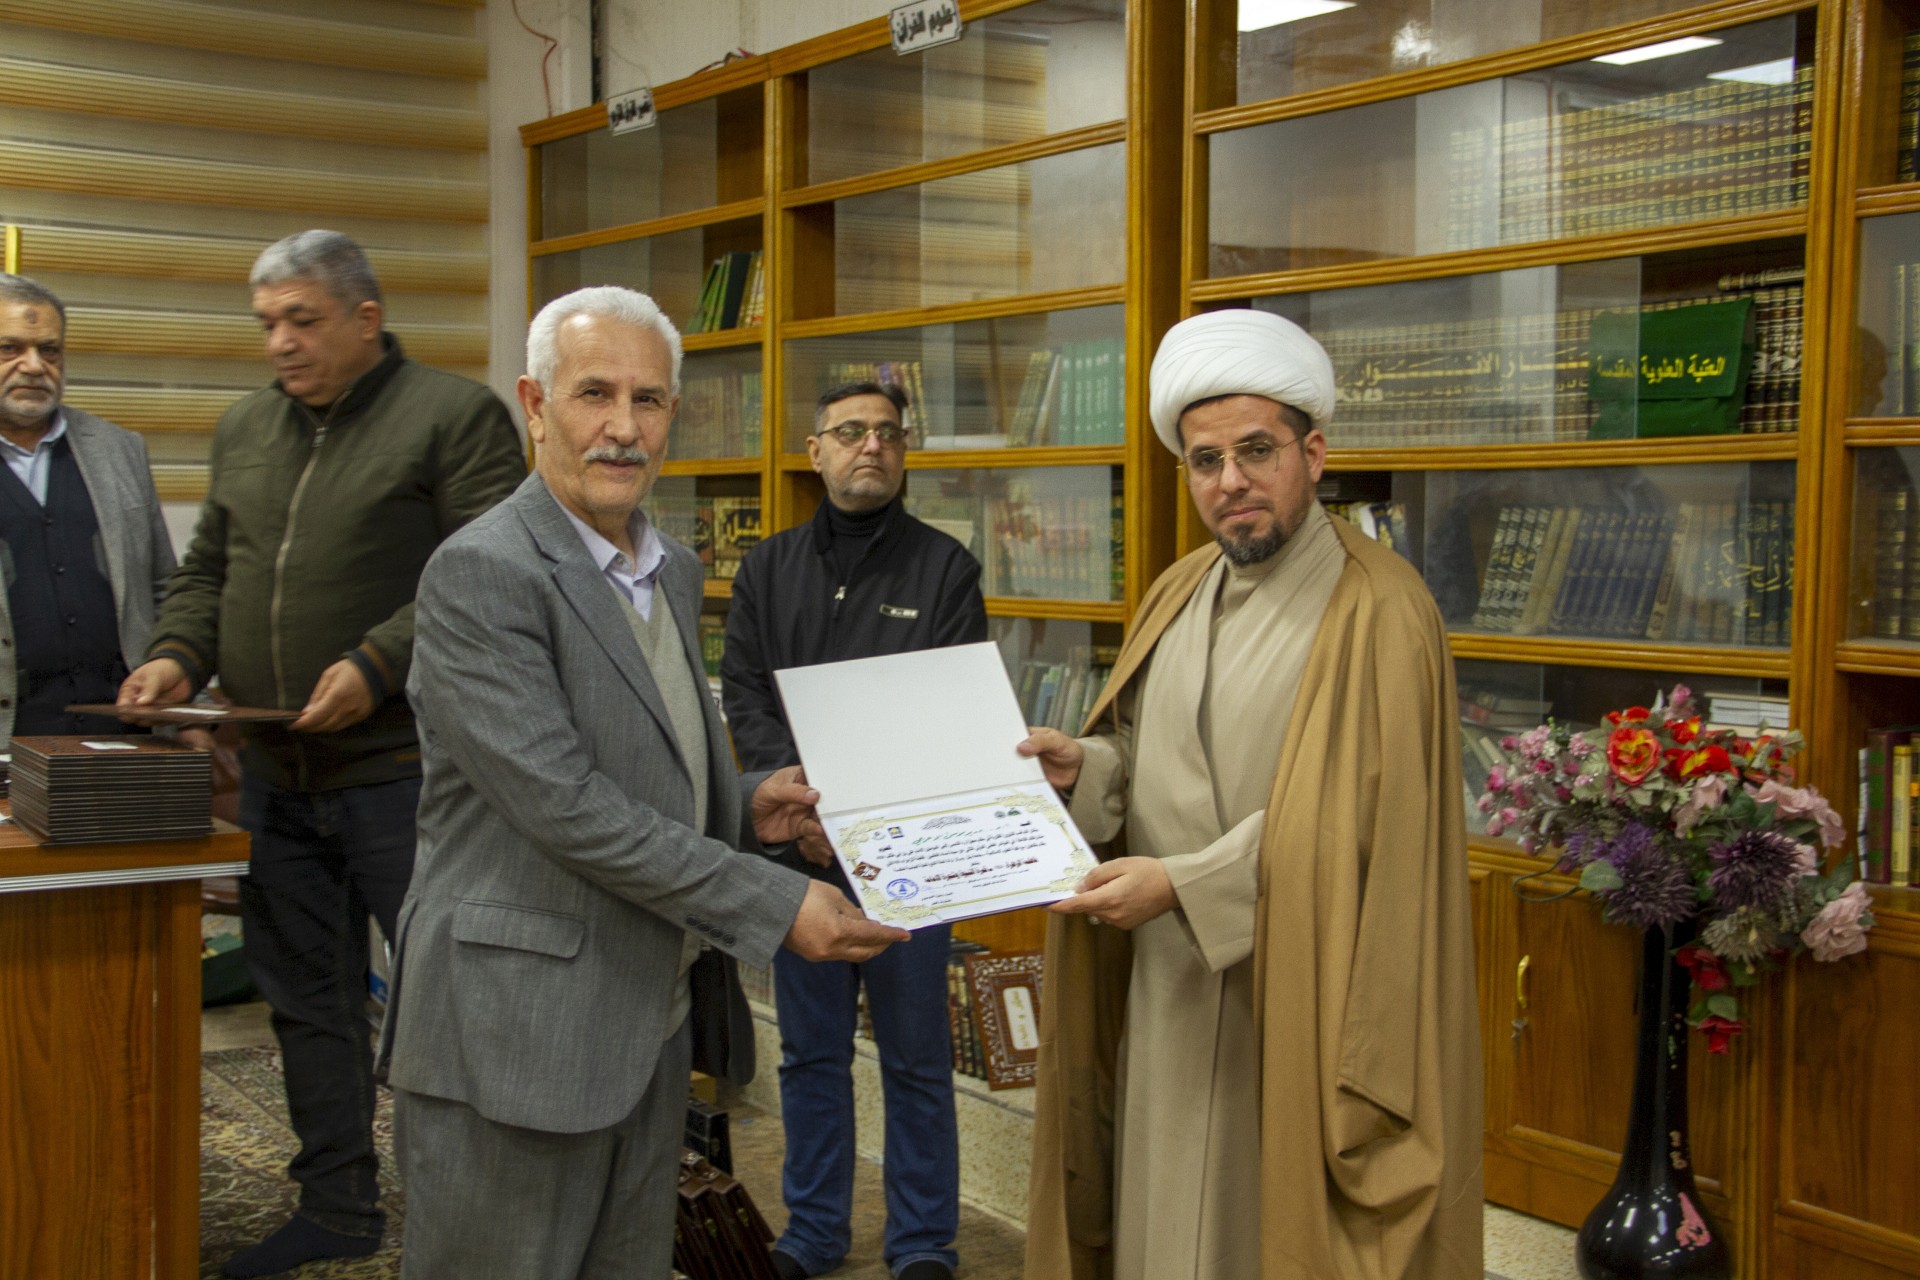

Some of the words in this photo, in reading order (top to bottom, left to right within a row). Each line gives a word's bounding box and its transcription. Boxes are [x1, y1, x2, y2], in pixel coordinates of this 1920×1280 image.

[897, 10, 926, 43] القرآن
[929, 4, 954, 37] علوم
[1640, 354, 1684, 385] العلوية
[1687, 353, 1726, 383] العتبة
